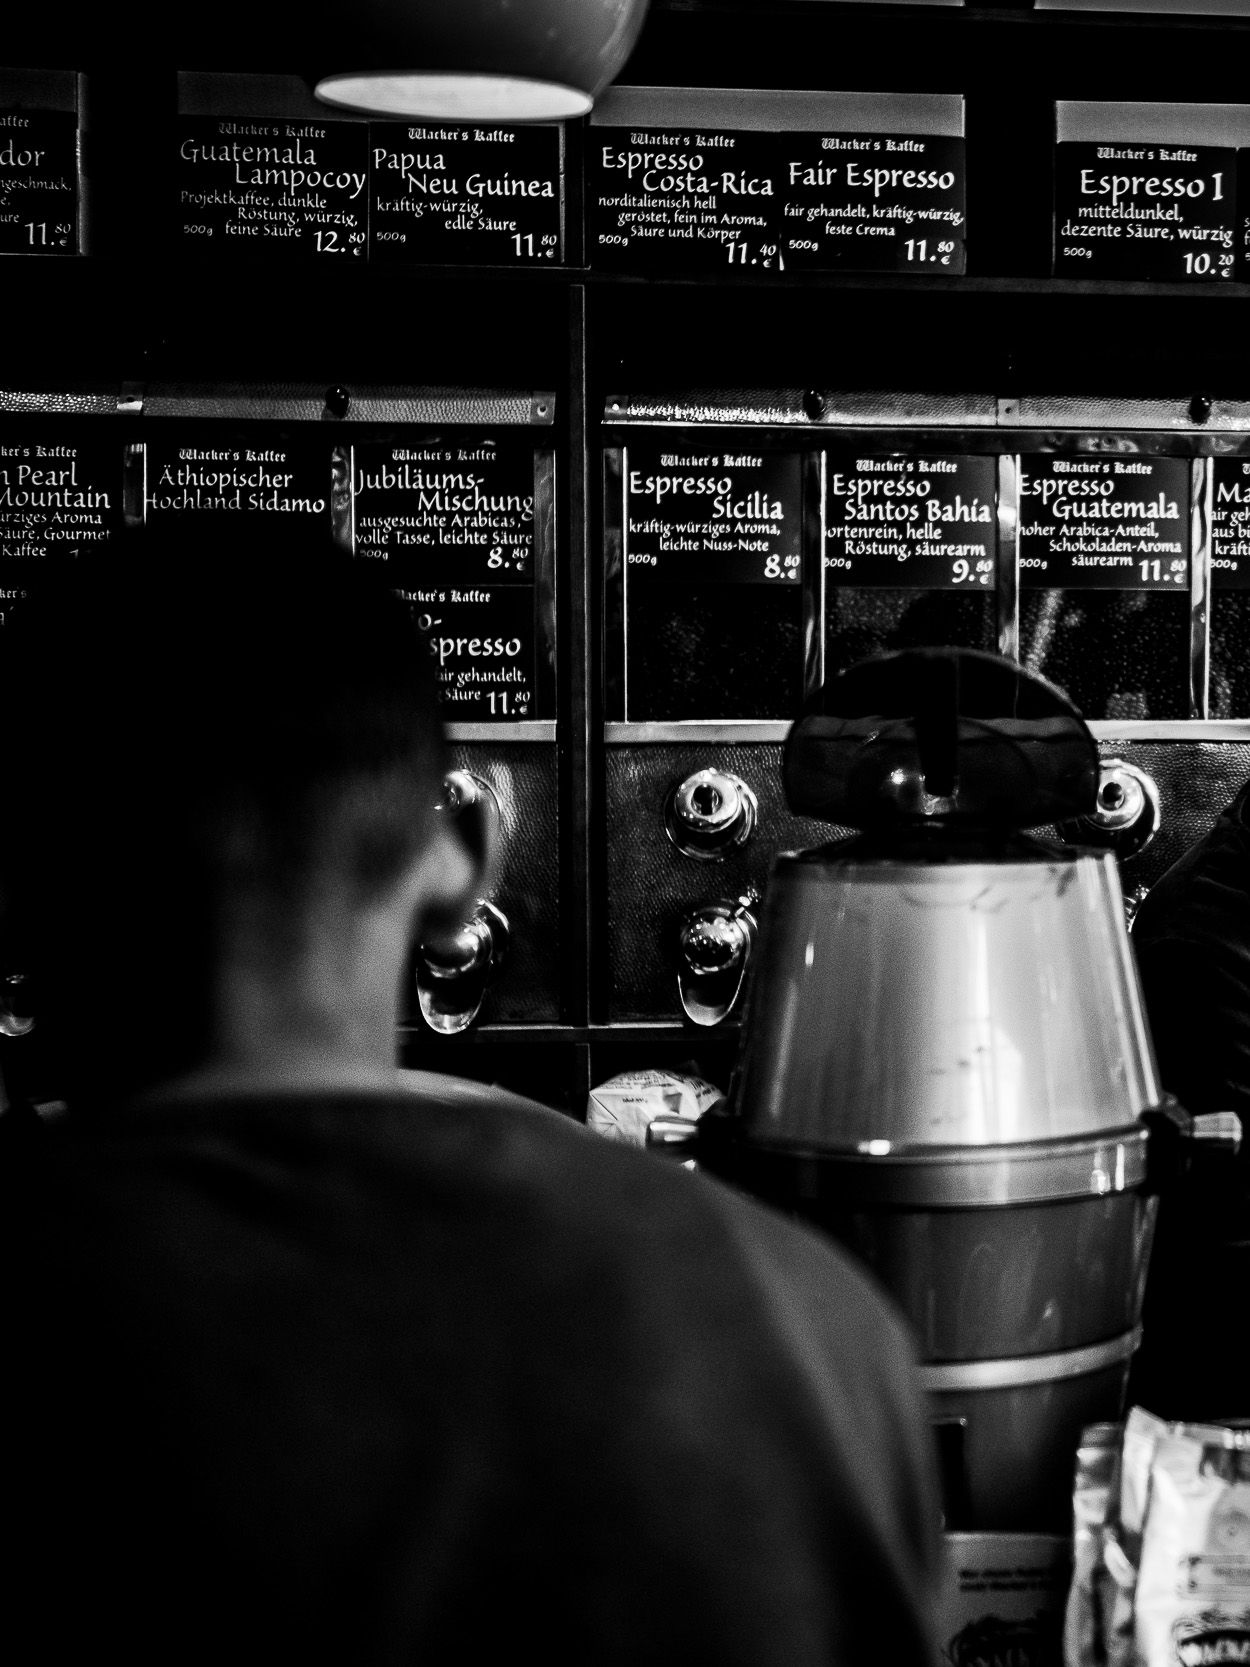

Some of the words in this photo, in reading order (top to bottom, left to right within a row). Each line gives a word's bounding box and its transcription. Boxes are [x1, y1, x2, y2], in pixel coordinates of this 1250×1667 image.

[220, 123, 278, 135] Wacker's
[286, 126, 325, 139] Kaffee
[408, 128, 468, 140] Wacker's
[474, 129, 514, 142] Kaffee
[631, 133, 690, 145] Wacker's
[696, 135, 735, 147] Kaffee
[0, 140, 45, 166] dor
[181, 138, 316, 166] Guatemala
[822, 138, 880, 150] Wacker's
[886, 140, 925, 152] Kaffee
[1097, 147, 1154, 159] Wacker's
[1159, 149, 1197, 161] Kaffee
[373, 149, 446, 179] Papua
[603, 147, 704, 179] Espresso
[234, 162, 365, 200] Lampocoy
[408, 173, 458, 194] Neu
[466, 172, 554, 197] Guinea
[643, 169, 774, 196] Costa-Rica
[789, 160, 837, 185] Fair
[847, 163, 954, 197] Espresso
[1081, 170, 1204, 207] Espresso
[182, 190, 274, 209] Projektkaffee,
[278, 191, 326, 208] dunkle
[377, 196, 483, 219] kräftig-würzig,
[599, 193, 690, 208] norditalienisch
[694, 195, 716, 209] hell
[238, 206, 299, 228] Röstung,
[304, 211, 357, 227] würzig,
[618, 211, 670, 227] geröstet,
[674, 209, 697, 223] fein
[701, 213, 717, 224] im
[721, 214, 767, 227] Aroma,
[785, 203, 804, 216] fair
[807, 203, 870, 222] gehandelt,
[873, 204, 965, 226] kräftig-würzig,
[1079, 201, 1183, 222] mitteldunkel,
[184, 225, 212, 236] 500g
[226, 220, 258, 235] feine
[264, 223, 301, 237] Säure
[445, 213, 475, 229] edle
[478, 217, 516, 231] Säure
[826, 221, 852, 234] feste
[856, 224, 895, 236] Crema
[377, 232, 406, 242] 500g
[599, 235, 628, 246] 500g
[631, 225, 664, 237] Säure
[669, 225, 693, 238] und
[698, 228, 741, 244] Körper
[1061, 219, 1121, 237] dezente
[1126, 224, 1174, 240] Säure,
[1178, 226, 1233, 248] würzig
[789, 240, 818, 251] 500g
[1064, 248, 1092, 258] 500g
[36, 446, 76, 457] Kaffee
[179, 449, 239, 460] Wacker's
[246, 450, 285, 462] Kaffee
[392, 450, 451, 460] Wacker's
[458, 450, 496, 460] Kaffee
[661, 455, 718, 466] Wacker's
[723, 455, 762, 467] Kaffee
[855, 459, 914, 472] Wacker's
[918, 460, 957, 473] Kaffee
[1052, 461, 1110, 474] Wacker's
[1113, 462, 1153, 475] Kaffee
[17, 461, 77, 486] Pearl
[160, 465, 293, 495] Äthiopischer
[354, 463, 485, 496] Jubiläums-
[630, 471, 732, 505] Espresso
[832, 473, 931, 506] Espresso
[1020, 473, 1115, 506] Espresso
[249, 490, 325, 513] Sidamo
[417, 485, 533, 522] Mischung
[712, 490, 784, 520] Sicilia
[844, 498, 920, 521] Santos
[925, 494, 992, 523] Bahia
[1052, 491, 1180, 521] Guatemala
[52, 512, 102, 524] Aroma
[360, 510, 447, 534] ausgesuchte
[451, 512, 520, 529] Arabicas,
[44, 527, 109, 540] Gourmet
[355, 528, 390, 545] volle
[397, 531, 434, 545] Tasse,
[439, 528, 487, 544] leichte
[492, 530, 533, 546] Säure
[630, 517, 731, 539] kräftig-würziges
[734, 522, 781, 536] Aroma,
[826, 524, 903, 541] ortenrein,
[907, 522, 942, 539] helle
[1059, 521, 1160, 539] Arabica-Anteil,
[1211, 527, 1235, 538] aus
[3, 542, 46, 556] Kaffee
[660, 536, 699, 550] leichte
[703, 539, 769, 551] Nuss-Note
[844, 540, 911, 562] Röstung,
[915, 542, 986, 556] säurearm
[1049, 537, 1182, 553] Schokoladen-Aroma
[361, 550, 388, 560] 500g
[628, 554, 657, 566] 500g
[1071, 554, 1133, 567] säurearm
[451, 590, 490, 602] Kaffee
[457, 667, 525, 687] gehandelt,
